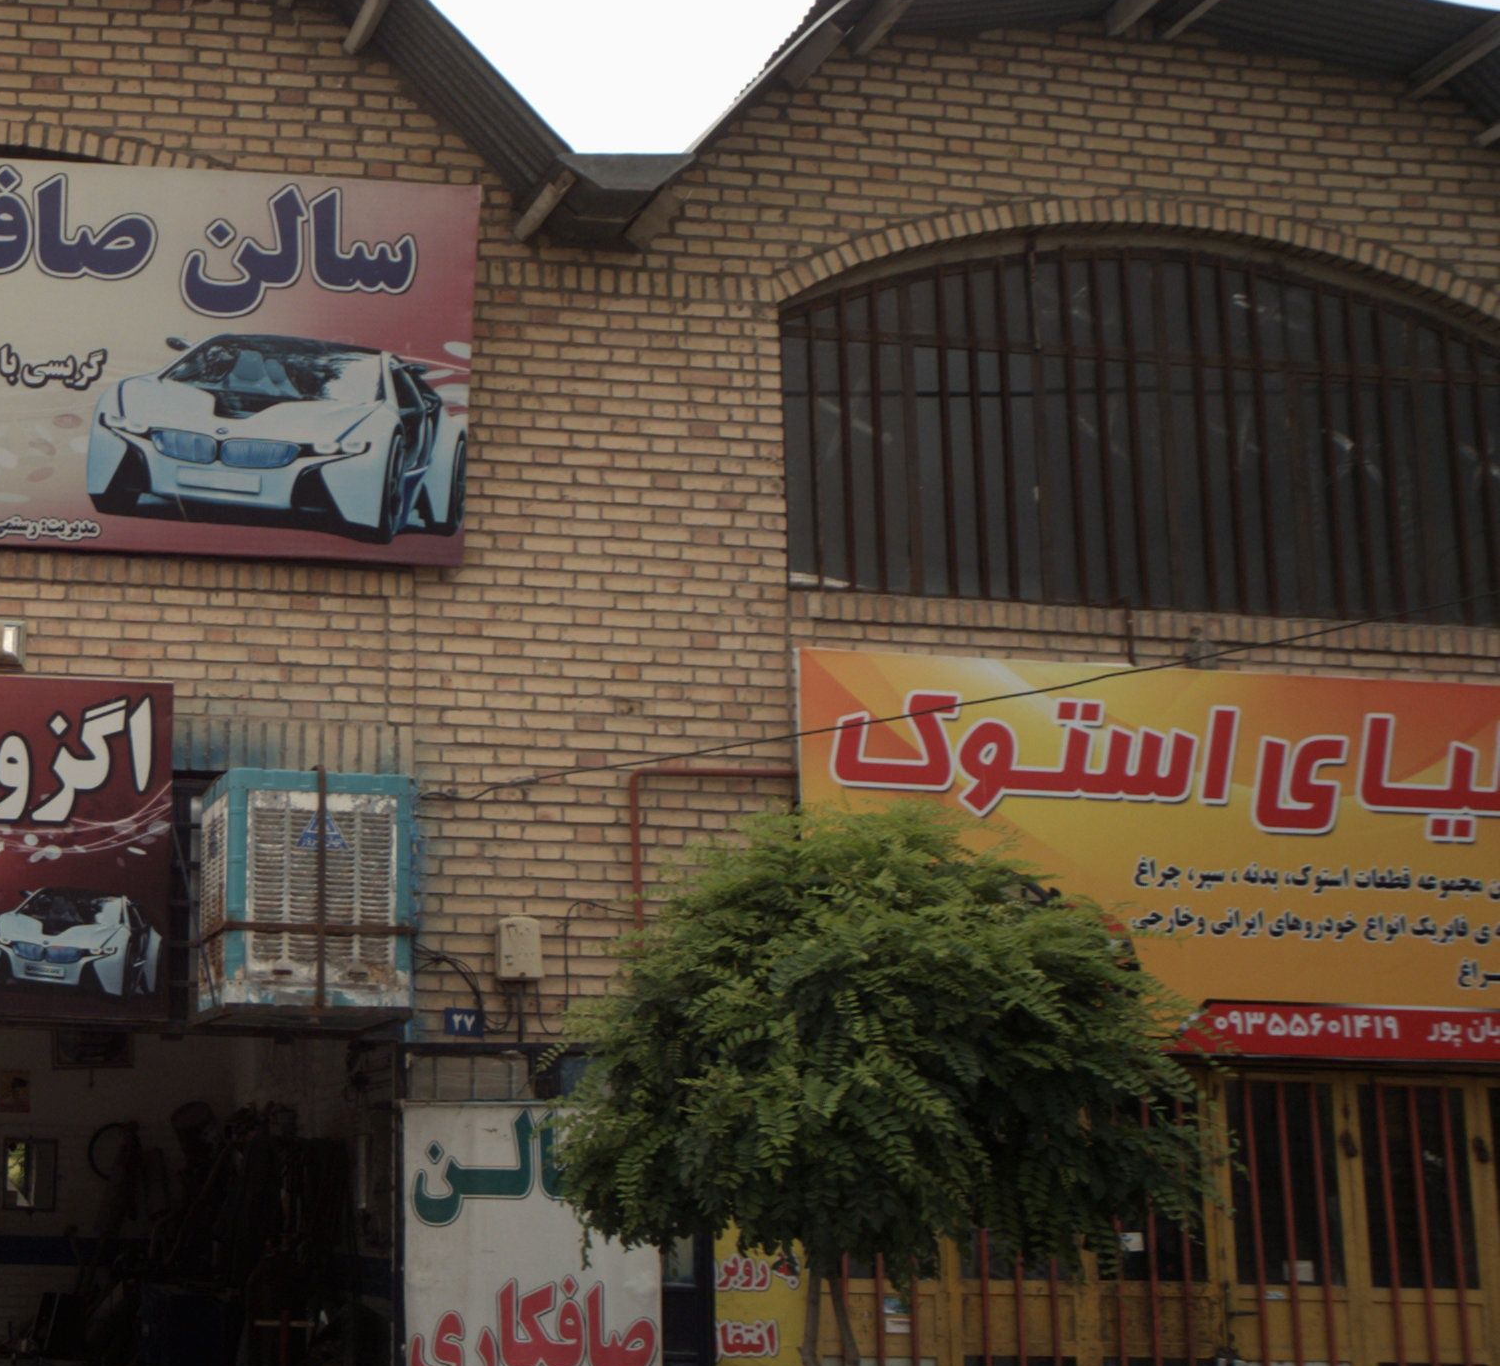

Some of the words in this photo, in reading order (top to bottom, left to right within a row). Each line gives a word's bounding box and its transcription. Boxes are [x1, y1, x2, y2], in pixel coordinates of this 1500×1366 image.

[180, 182, 416, 316] سالن
[21, 349, 107, 389] گریسی
[830, 689, 1243, 819] استوک
[1251, 712, 1500, 843] یای
[1134, 856, 1181, 888] چراغ
[1355, 867, 1412, 889] قطعات
[1417, 875, 1483, 900] مجموعه
[1211, 907, 1264, 937] ایرانی
[1268, 911, 1358, 940] خودروهای
[1363, 915, 1407, 942] انواع
[1411, 916, 1468, 943] فابریک
[1458, 958, 1500, 988] راغ
[1213, 1009, 1400, 1040] ۰۹۳۵۵۶۰۱۴۱۹
[1426, 1020, 1463, 1048] پور
[412, 1106, 566, 1227] الن
[715, 1254, 771, 1291] روبر
[715, 1318, 779, 1359] انتقا
